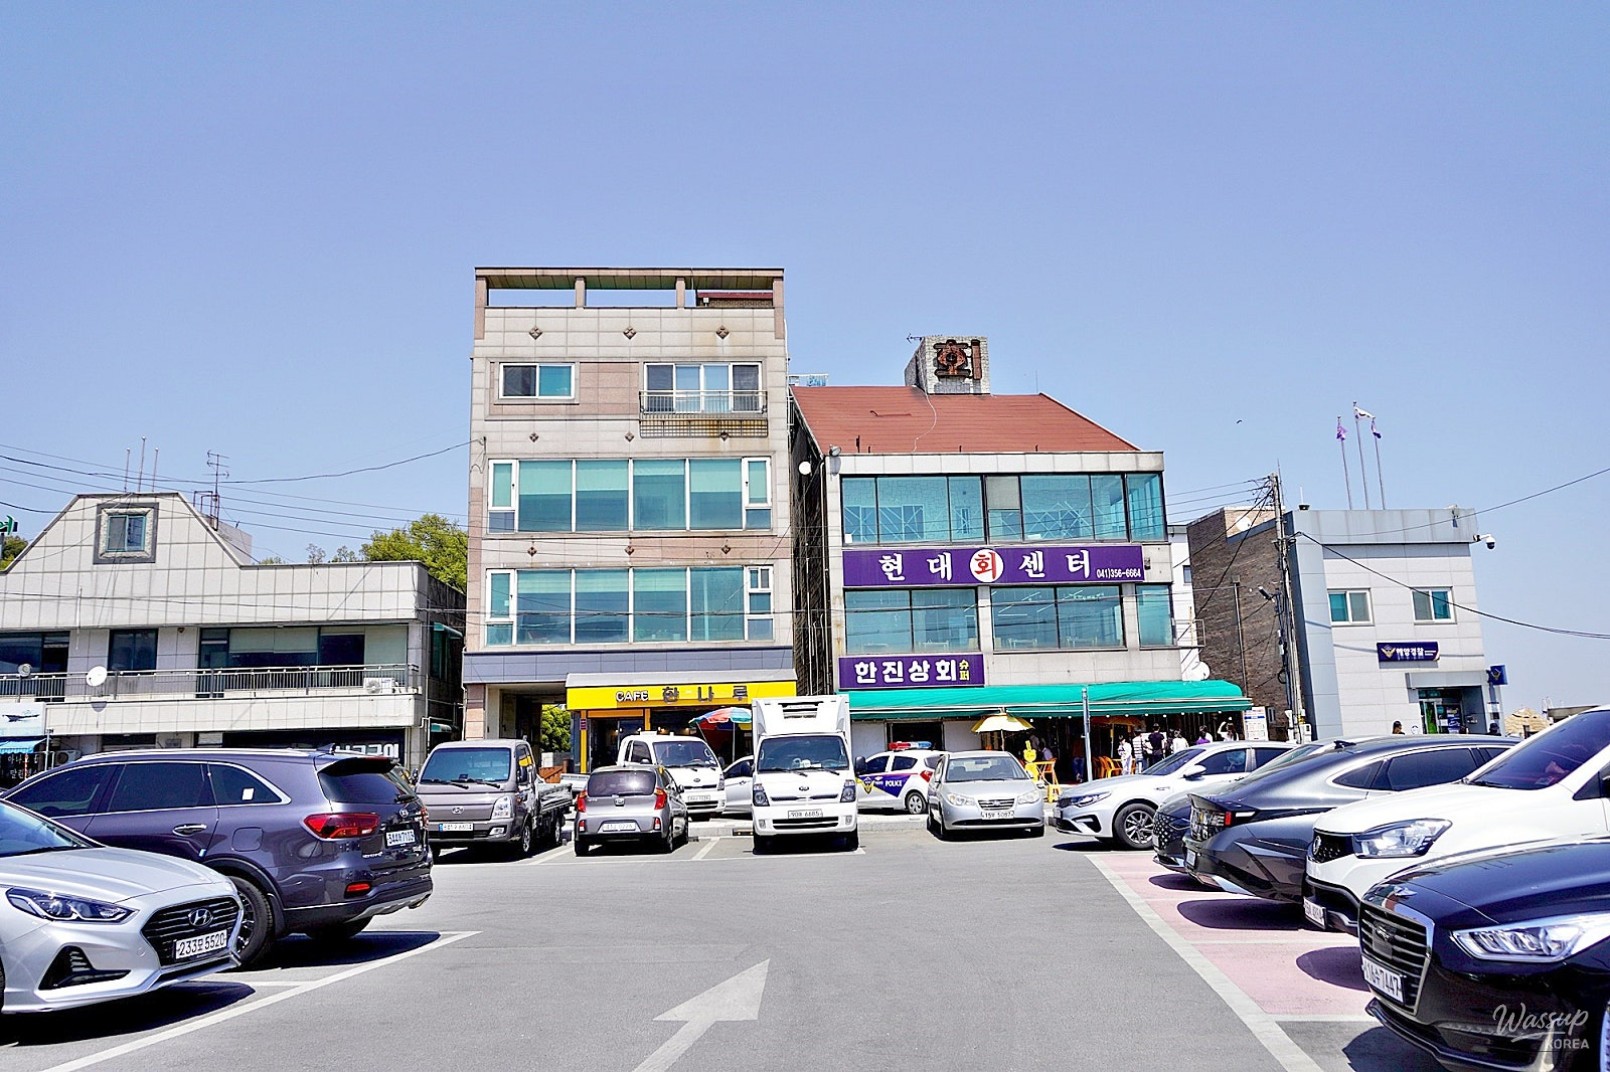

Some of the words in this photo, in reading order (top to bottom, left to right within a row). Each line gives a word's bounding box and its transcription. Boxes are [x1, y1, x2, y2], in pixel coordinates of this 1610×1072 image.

[854, 659, 957, 684] 한진상회
[959, 659, 970, 681] 슈퍼
[615, 690, 649, 702] CAFE
